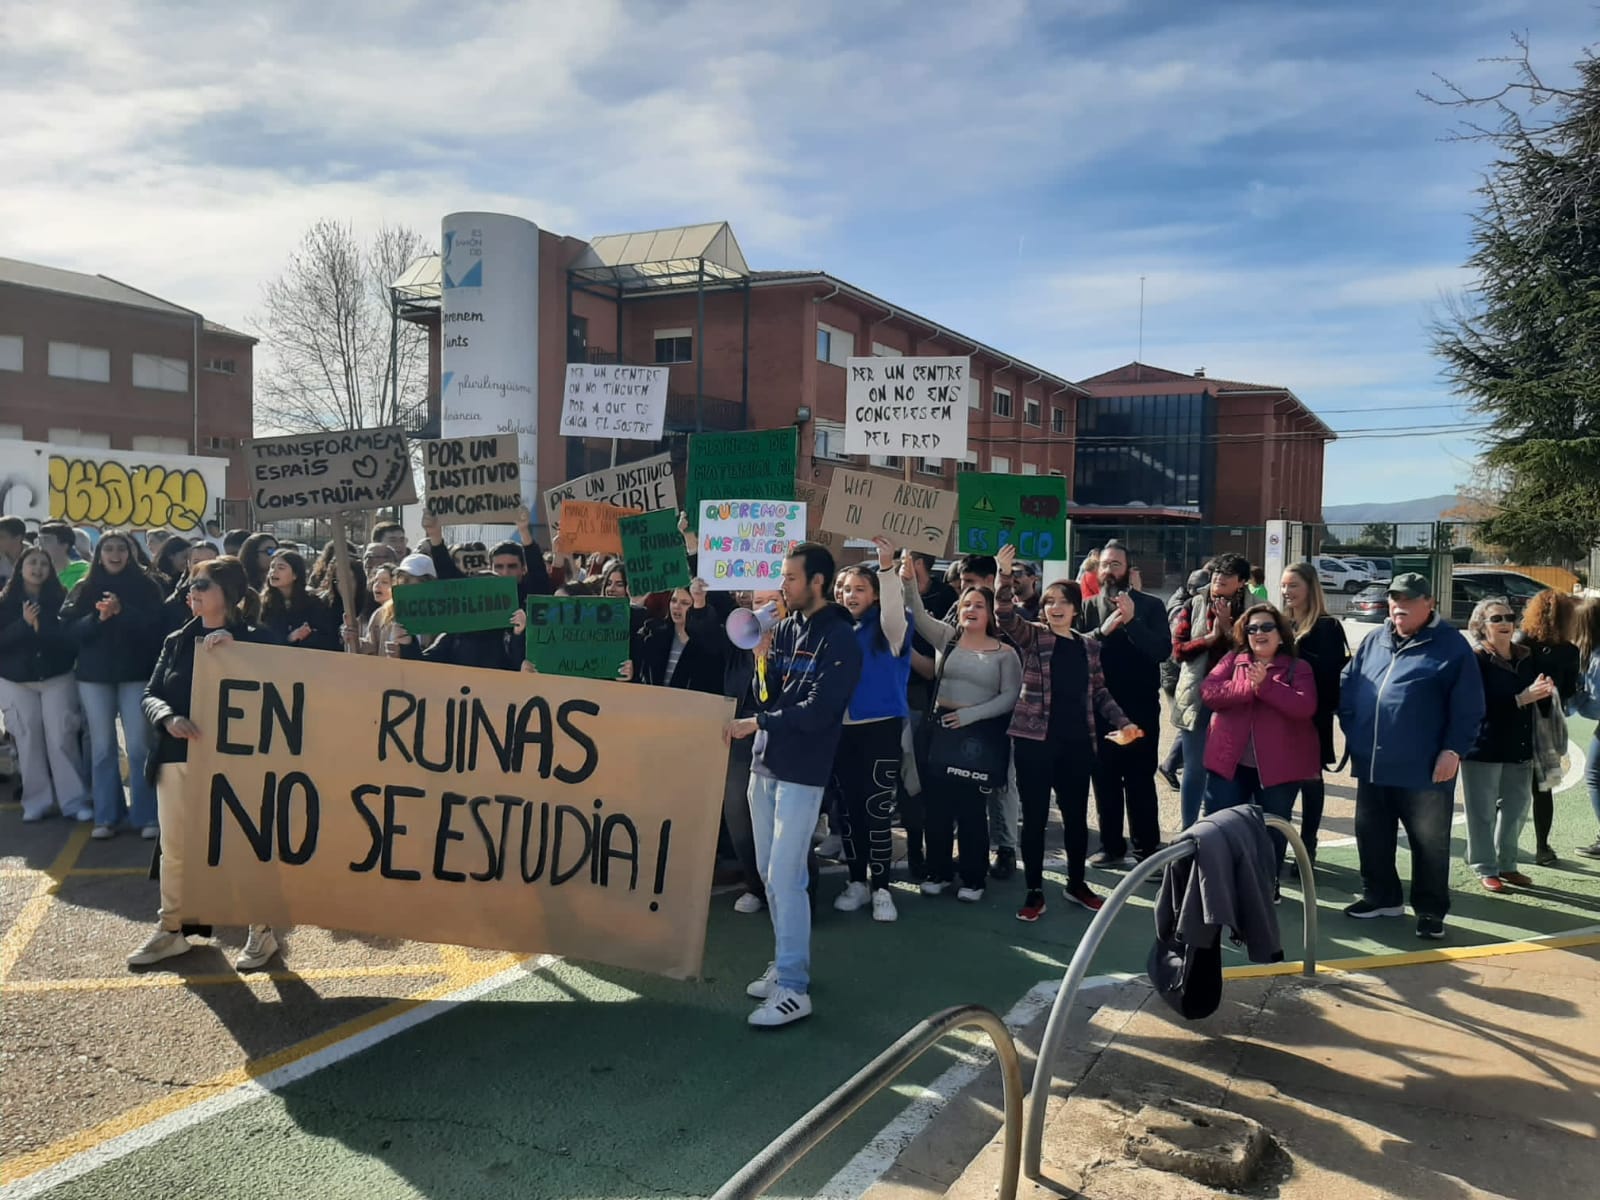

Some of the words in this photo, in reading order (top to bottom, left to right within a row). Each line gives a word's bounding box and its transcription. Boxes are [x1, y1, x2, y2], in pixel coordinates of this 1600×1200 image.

[593, 367, 606, 378] UN
[614, 367, 661, 382] CENTRE
[852, 366, 874, 381] PER
[884, 364, 905, 381] UN
[913, 365, 963, 381] CENTRE
[568, 383, 580, 395] ON
[585, 382, 597, 393] NO
[868, 384, 887, 402] ON
[894, 385, 915, 401] NO
[927, 385, 961, 402] ENS
[592, 402, 599, 414] A
[605, 402, 627, 414] QUE
[595, 417, 609, 430] EL
[612, 420, 653, 433] SOSTRE
[252, 432, 404, 458] TRANSFORMEM
[864, 430, 890, 447] PEL
[901, 433, 941, 448] FRED
[427, 440, 466, 467] POR
[469, 438, 497, 461] UN
[428, 462, 519, 490] INSTITUTO
[550, 486, 576, 511] POR
[585, 478, 605, 497] UN
[616, 461, 673, 492] INSTITUTO
[844, 475, 874, 498] WIFI
[893, 484, 940, 509] ABSENT
[706, 503, 800, 521] QUEREMOS
[845, 504, 863, 525] EN
[738, 522, 786, 538] UNAS
[216, 678, 305, 755] EN
[207, 770, 319, 867] NO
[349, 784, 426, 880] SE
